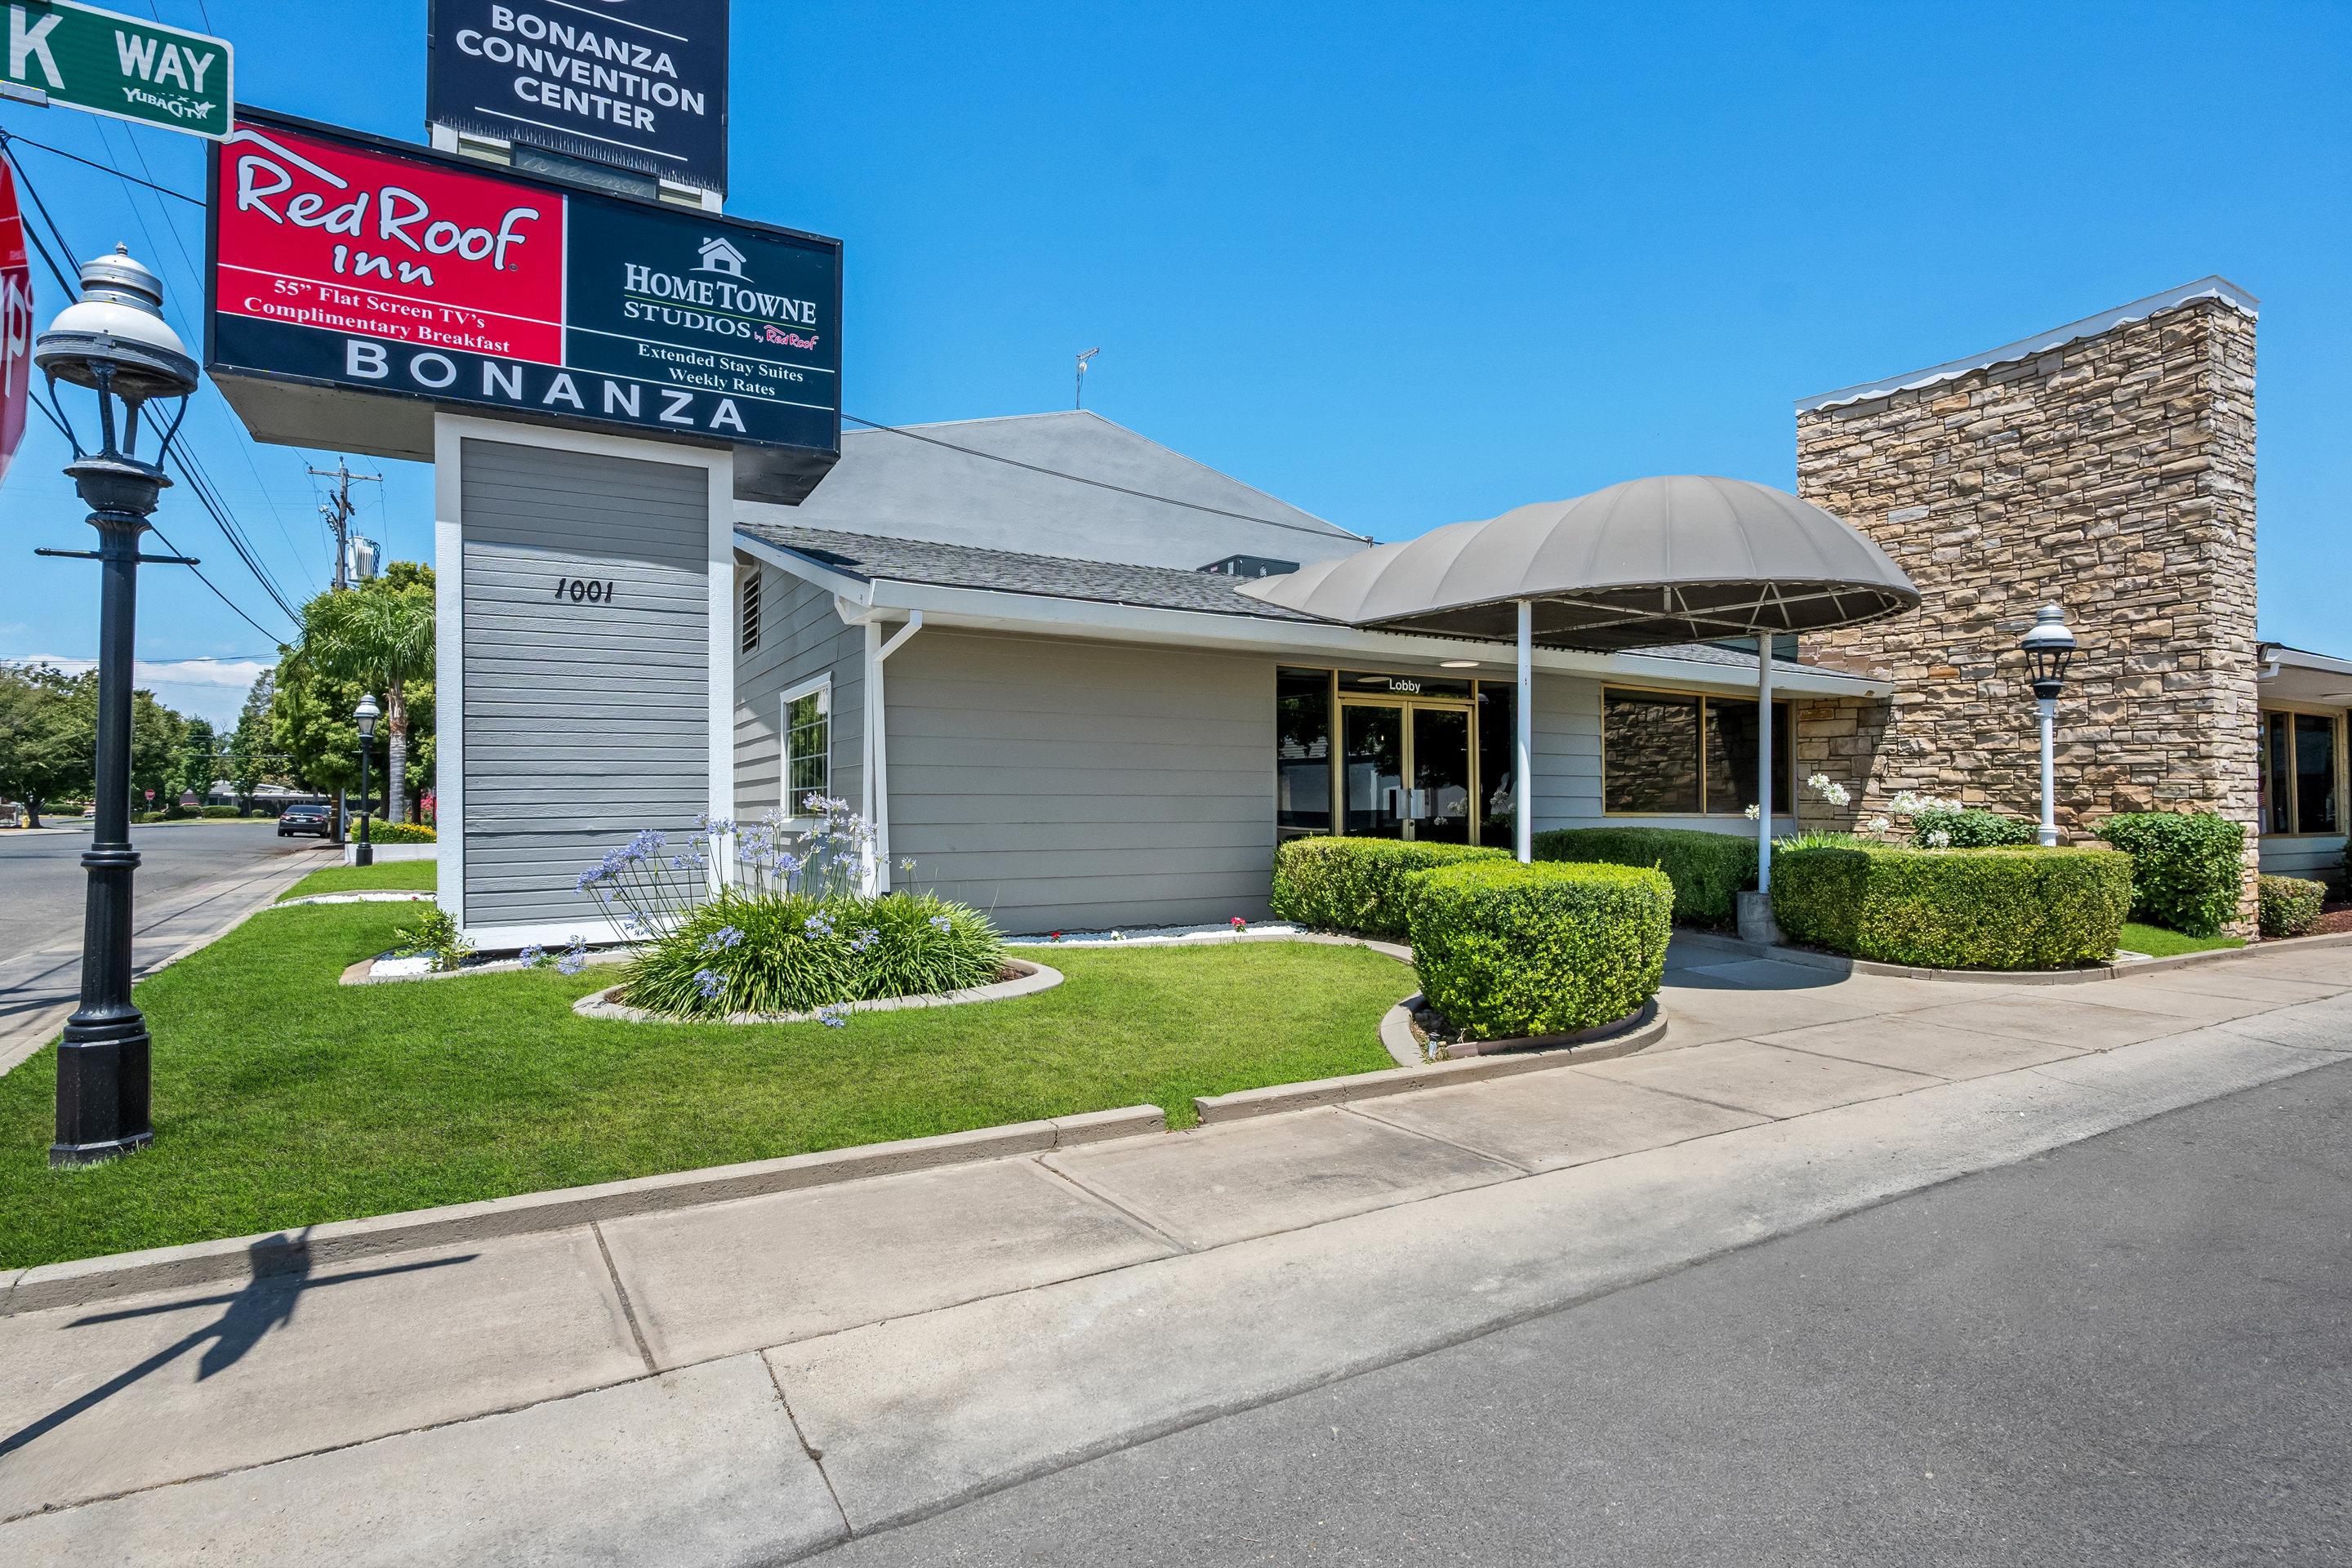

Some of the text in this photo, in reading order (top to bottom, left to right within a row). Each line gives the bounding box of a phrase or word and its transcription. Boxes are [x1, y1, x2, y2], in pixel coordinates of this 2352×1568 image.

[114, 29, 216, 93] WAY
[492, 5, 678, 78] BONANZA
[456, 29, 705, 115] CONVENTION
[514, 76, 655, 132] CENTER
[236, 154, 540, 271] Red Roof
[243, 296, 510, 353] Complimentary Breakfast
[318, 287, 360, 307] Flat
[367, 296, 433, 319] Screen
[624, 301, 819, 350] STUDIOS by Red Roof
[346, 339, 746, 433] BONANZA
[638, 343, 804, 382] Extended Stay Suites
[668, 368, 775, 396] Weekly Rates
[555, 578, 612, 603] 1001
[1389, 678, 1421, 693] Lobby
